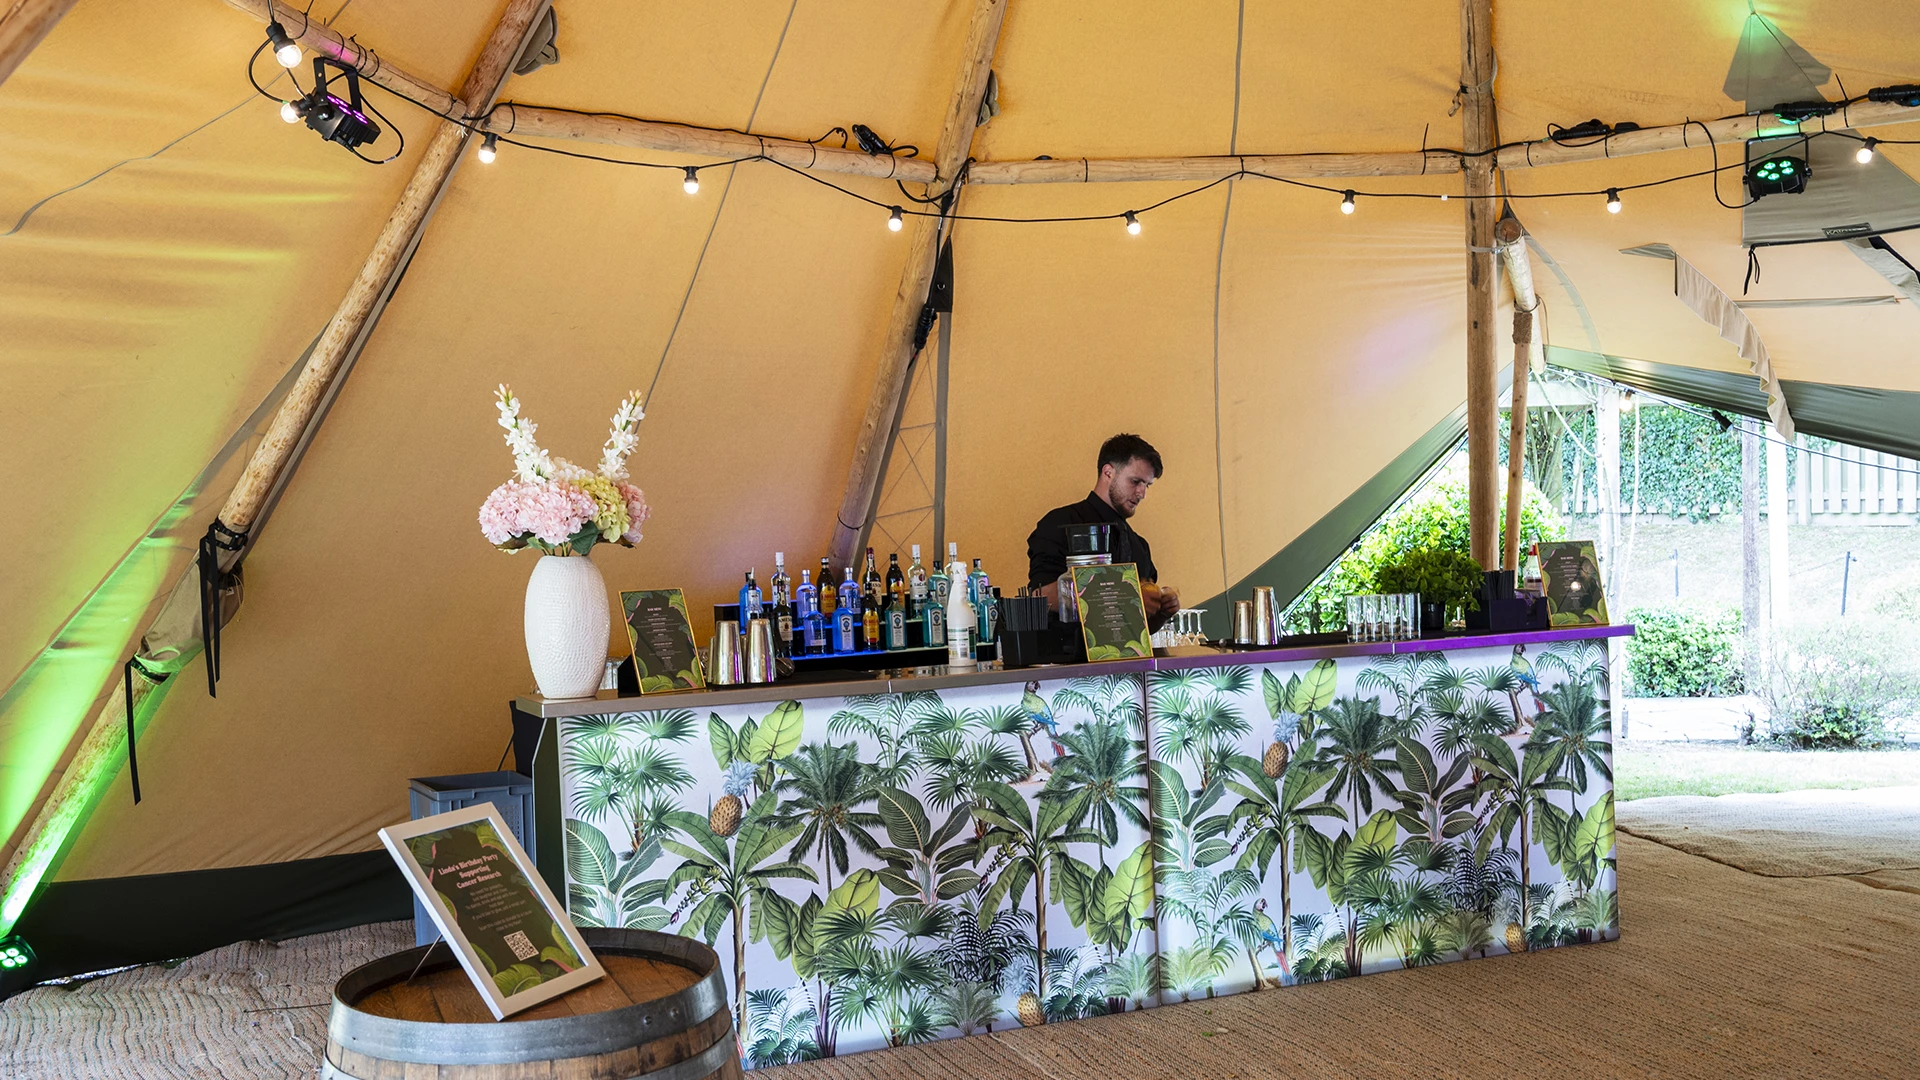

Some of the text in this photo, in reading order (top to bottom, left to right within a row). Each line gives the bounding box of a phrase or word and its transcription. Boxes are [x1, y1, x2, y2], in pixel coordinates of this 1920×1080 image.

[438, 853, 499, 875] Linda's Birthday Party
[459, 865, 491, 879] Supporting
[456, 870, 502, 889] Cancer Research
